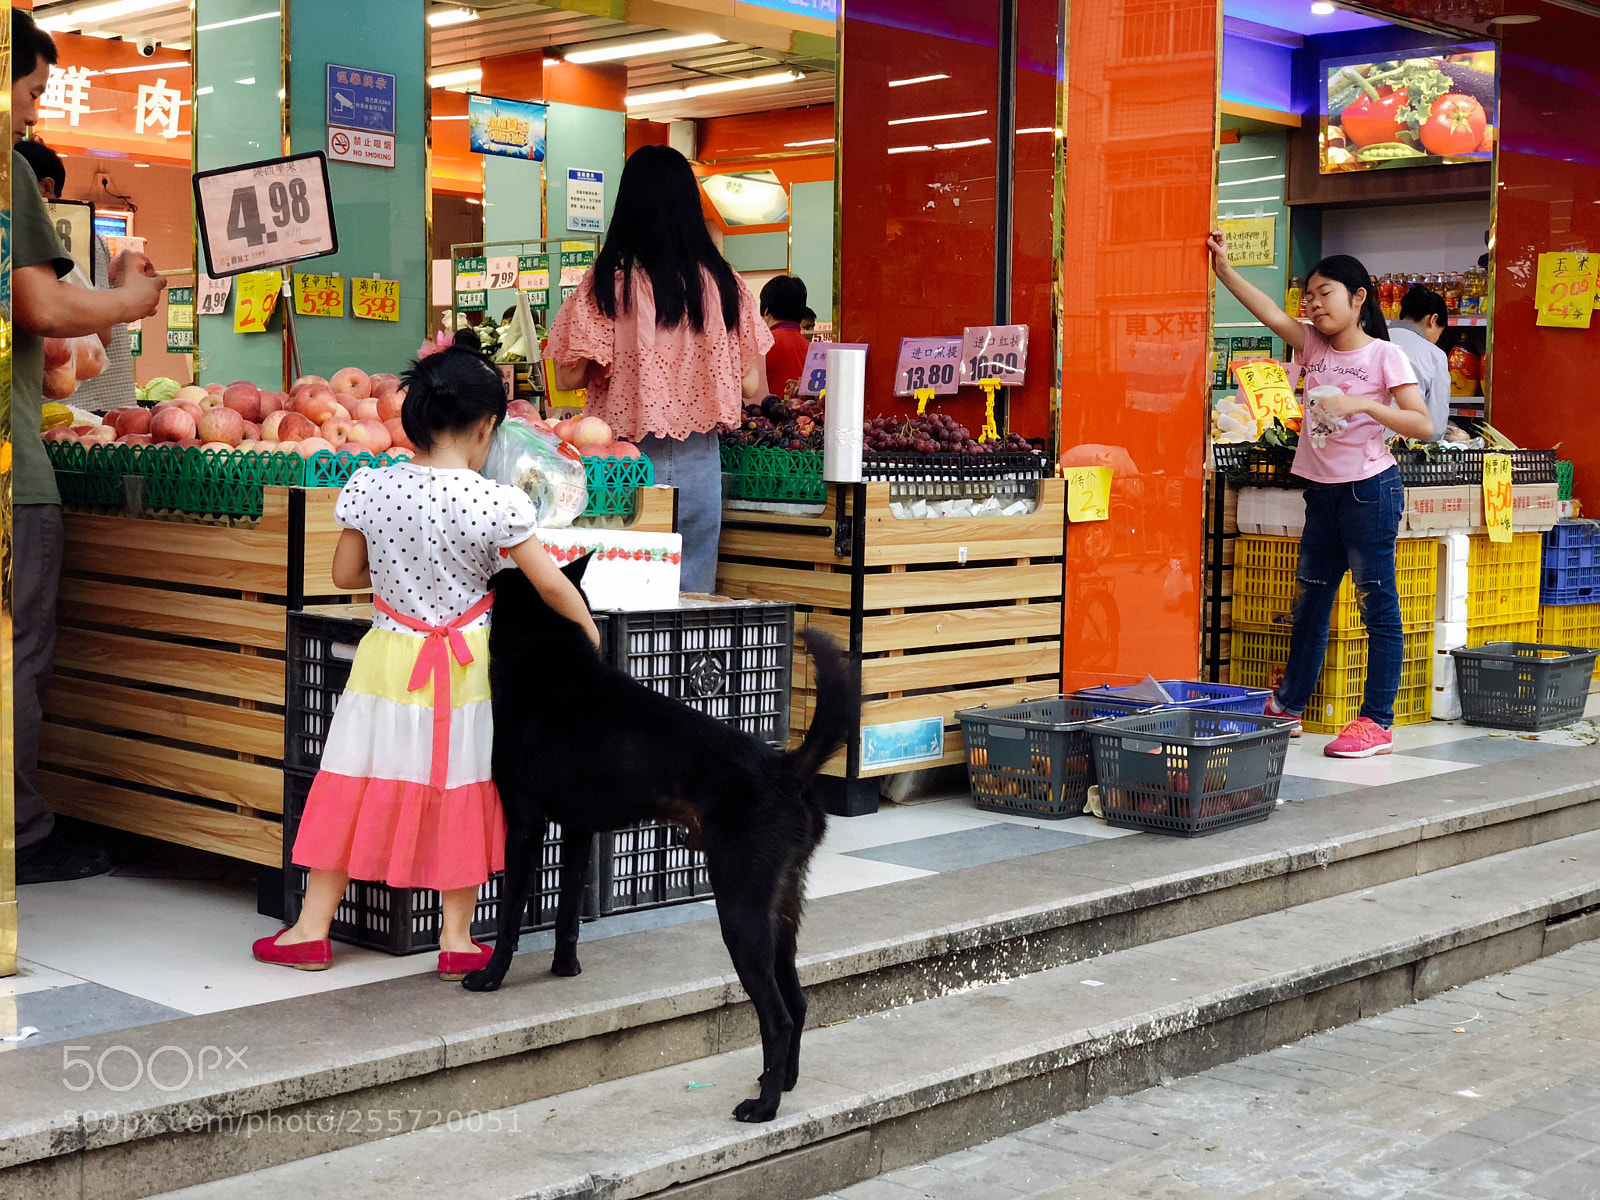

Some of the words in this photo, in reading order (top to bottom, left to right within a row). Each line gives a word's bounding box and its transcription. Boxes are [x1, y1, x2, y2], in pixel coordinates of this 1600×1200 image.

[38, 65, 181, 139] 鲜肉
[353, 136, 392, 150] 禁止吸烟
[365, 151, 392, 161] SMOKING
[226, 177, 311, 248] 4.98
[1553, 256, 1590, 273] 玉米
[491, 271, 514, 288] 7.98
[974, 333, 1021, 349] 进口红提
[911, 346, 958, 360] 进口黑提
[906, 364, 954, 391] 13.80
[1255, 393, 1295, 418] 5.98
[1080, 490, 1097, 512] 2
